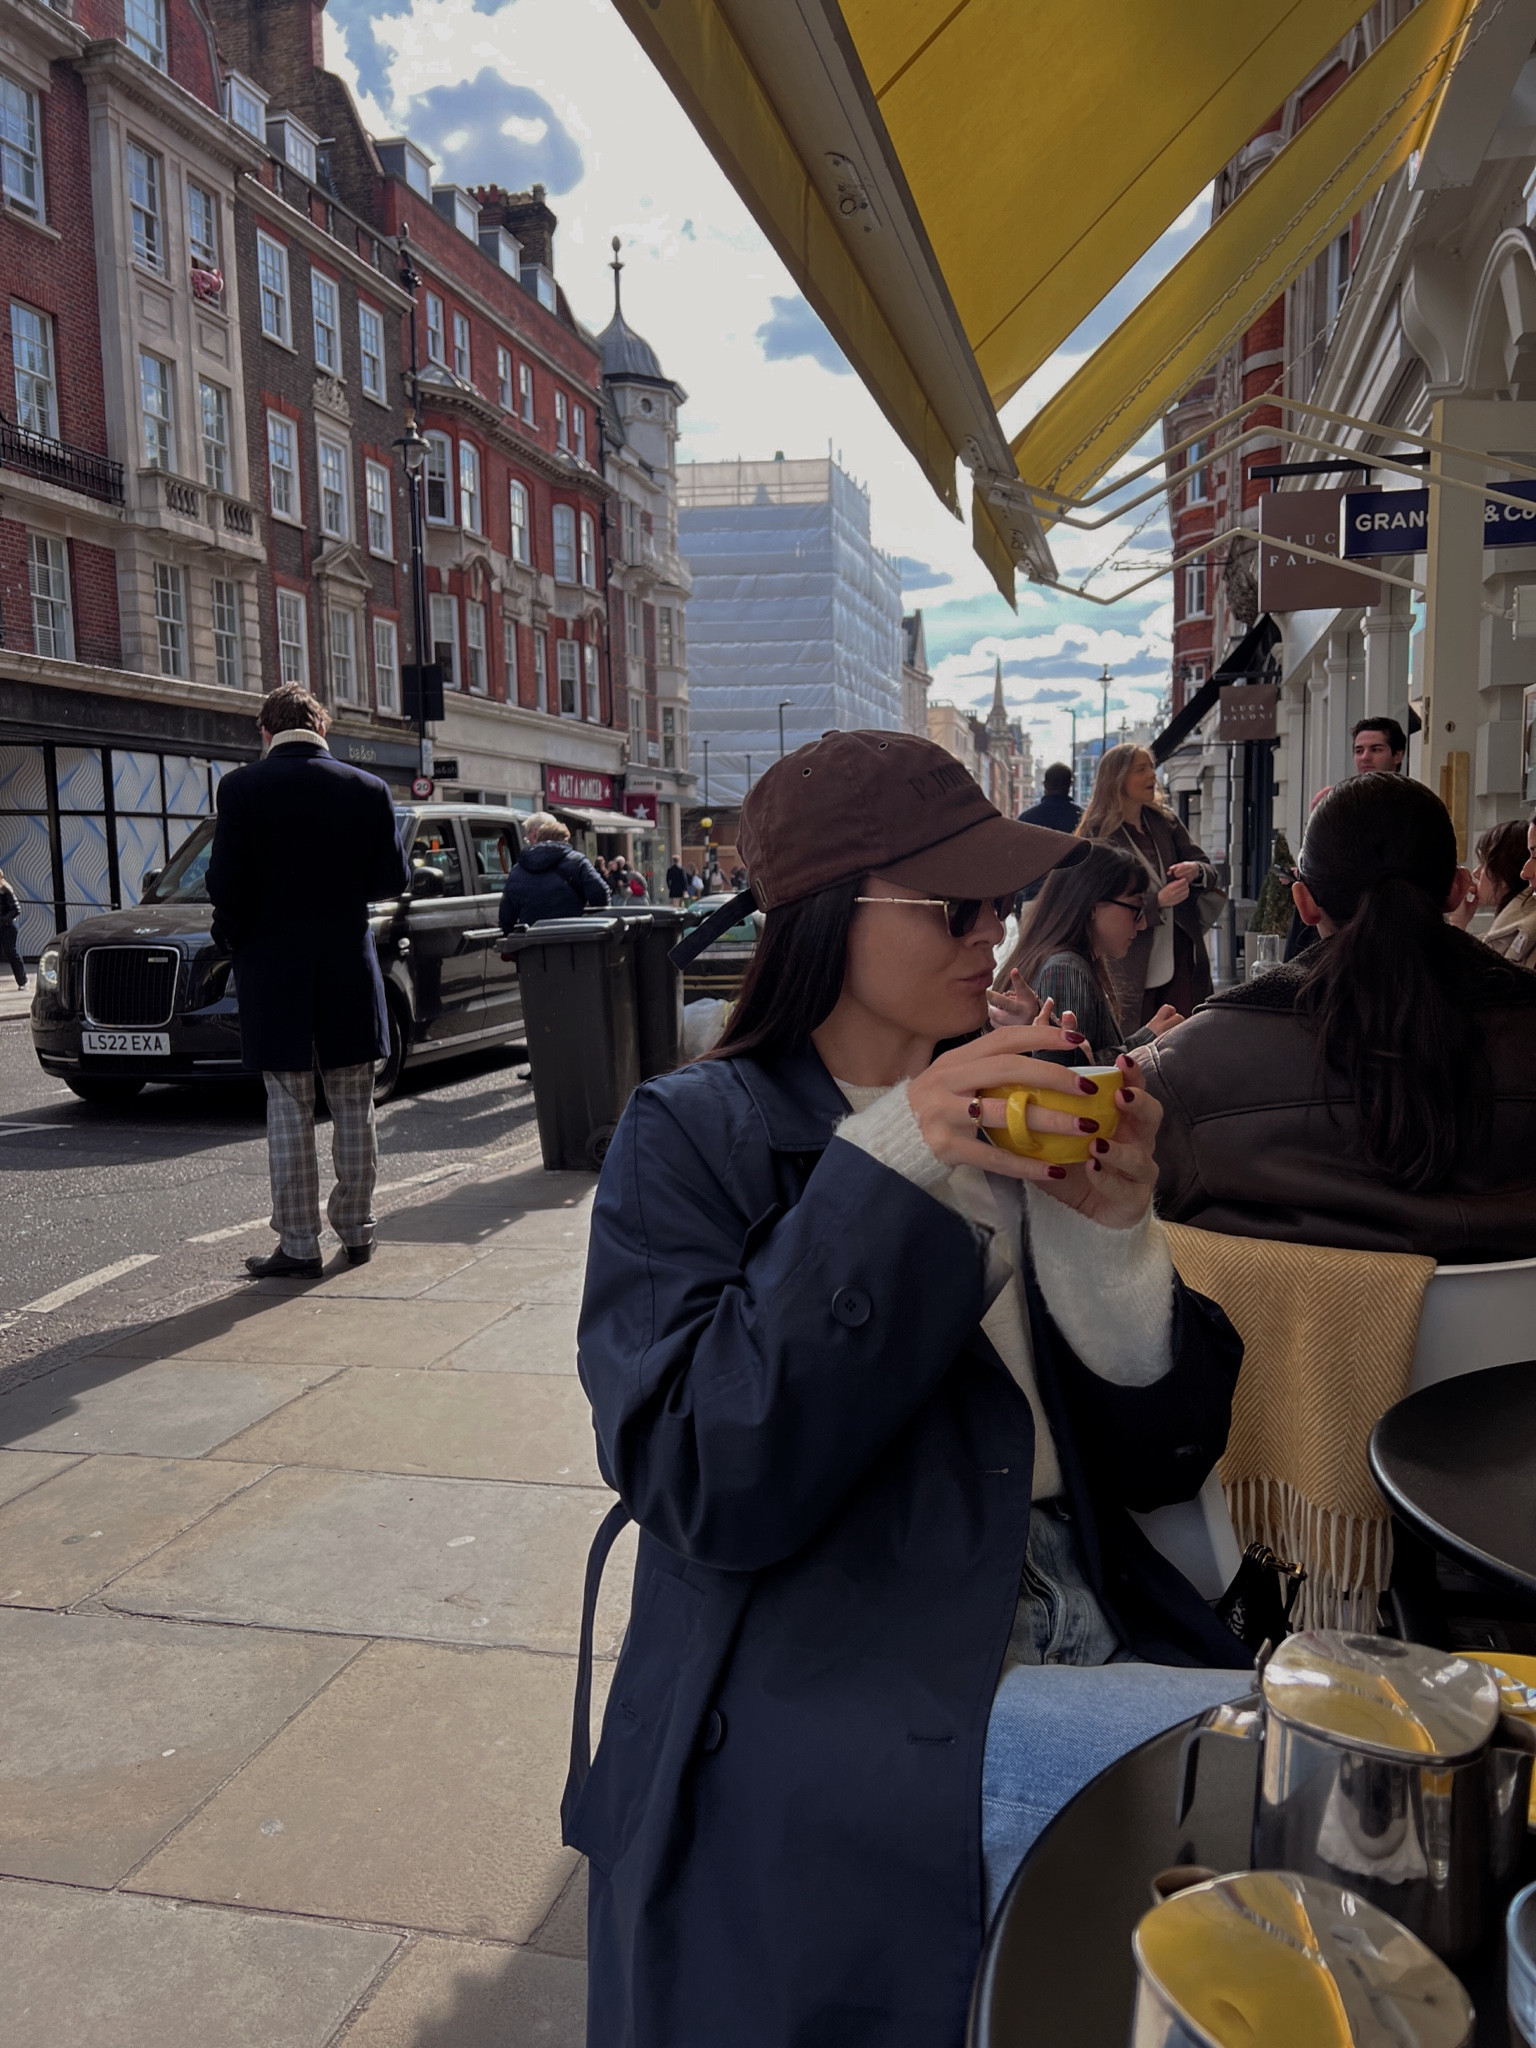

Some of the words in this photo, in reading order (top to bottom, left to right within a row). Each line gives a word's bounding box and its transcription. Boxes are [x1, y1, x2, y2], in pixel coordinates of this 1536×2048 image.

[1354, 510, 1430, 532] GRAN
[1484, 504, 1501, 523] &
[1230, 703, 1265, 713] LUCA
[1223, 712, 1273, 721] FALONI
[416, 783, 428, 791] 20
[88, 1034, 127, 1051] LS22
[131, 1035, 163, 1051] EXA
